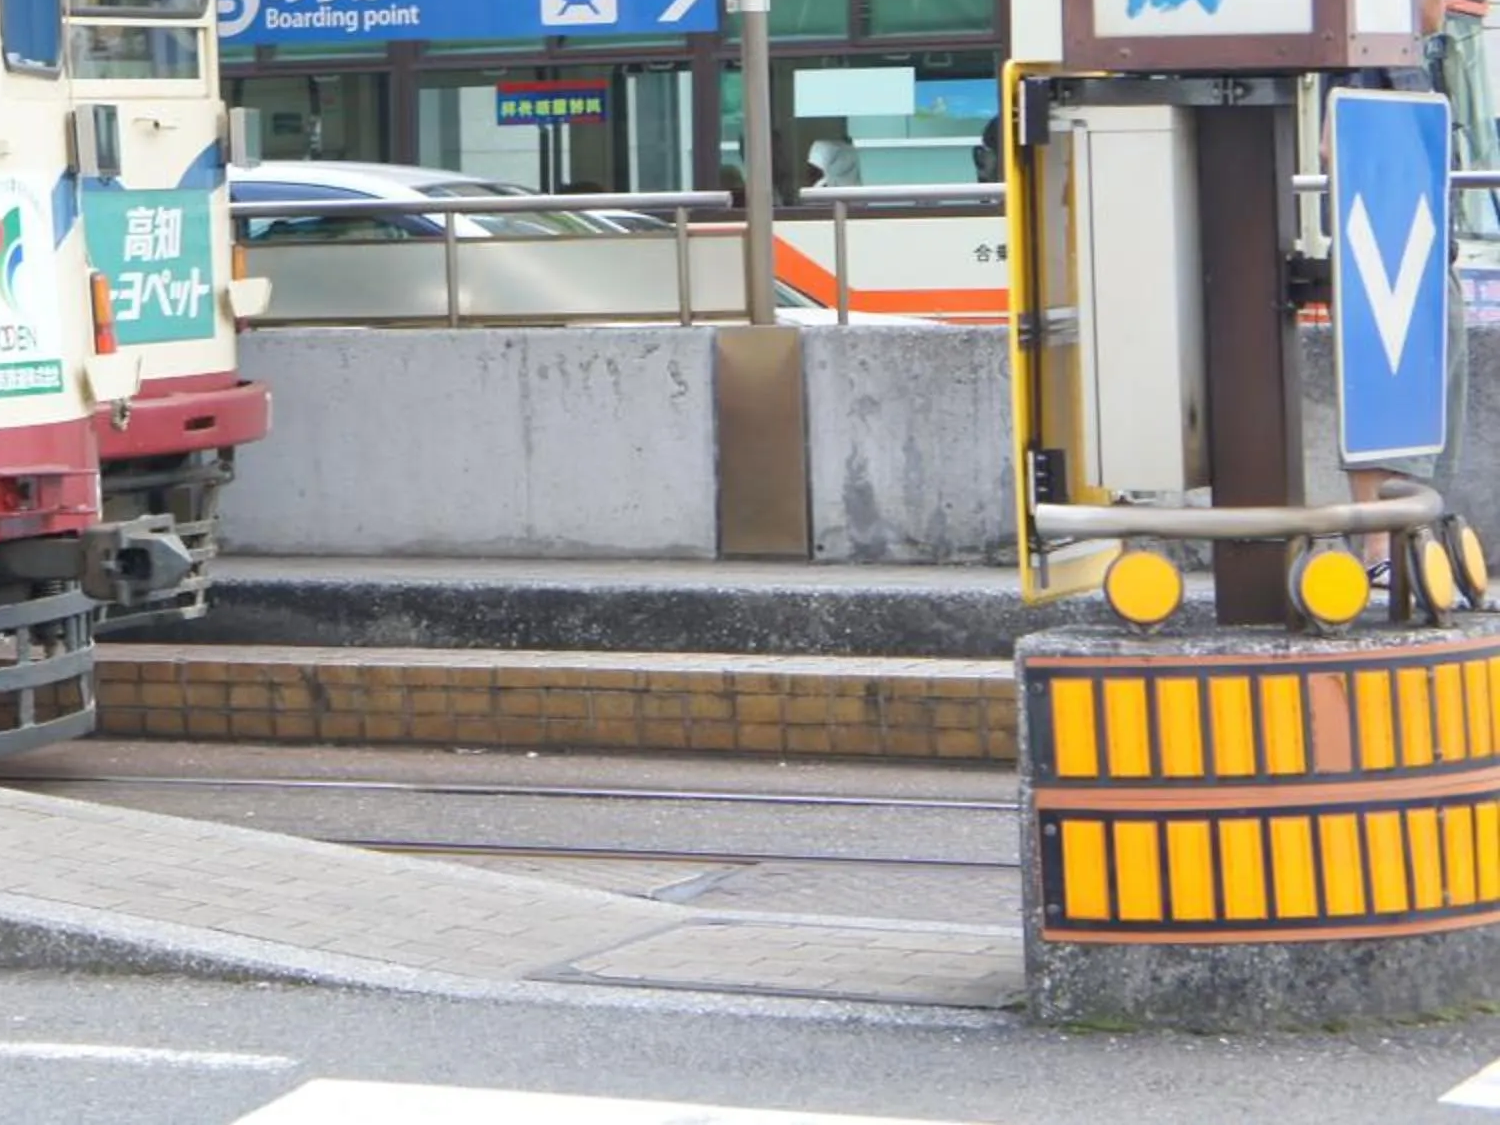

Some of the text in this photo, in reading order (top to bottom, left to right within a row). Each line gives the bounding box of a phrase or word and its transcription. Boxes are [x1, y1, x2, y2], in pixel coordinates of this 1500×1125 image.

[265, 4, 420, 32] Boarding point
[124, 206, 182, 263] 高知
